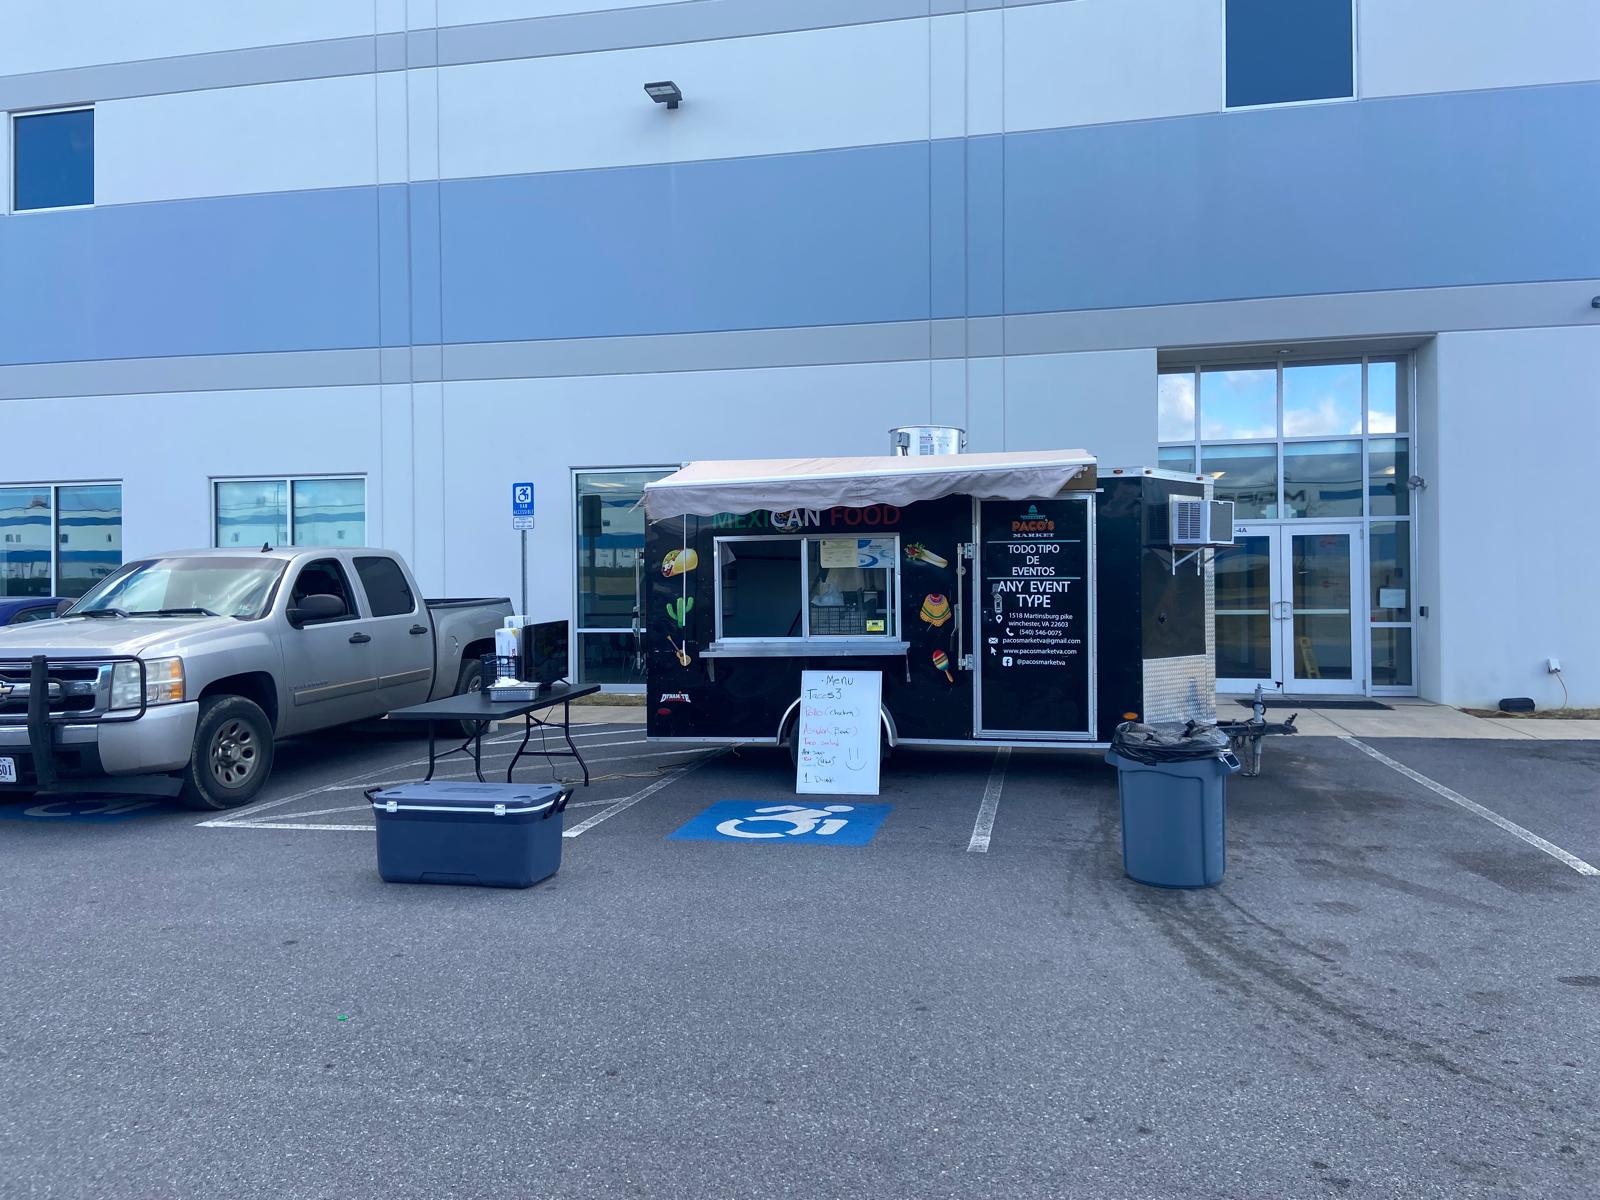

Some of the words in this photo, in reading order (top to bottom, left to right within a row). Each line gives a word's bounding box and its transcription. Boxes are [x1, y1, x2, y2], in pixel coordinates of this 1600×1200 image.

[712, 508, 820, 528] MEXICAN
[831, 506, 900, 526] FOOD
[1012, 519, 1055, 532] PACO'S
[1008, 544, 1036, 554] TODO
[1037, 544, 1060, 554] TIPO
[1026, 555, 1040, 565] DE
[1012, 566, 1055, 576] EVENTOS
[998, 580, 1025, 593] ANY
[1030, 580, 1071, 593] EVENT
[1016, 594, 1051, 608] TYPE
[1023, 612, 1060, 620] Martinsburg
[1002, 637, 1081, 645] pacosmarketva@gmail.com
[1017, 658, 1066, 666] @pacosmarketva
[826, 674, 854, 686] Menu
